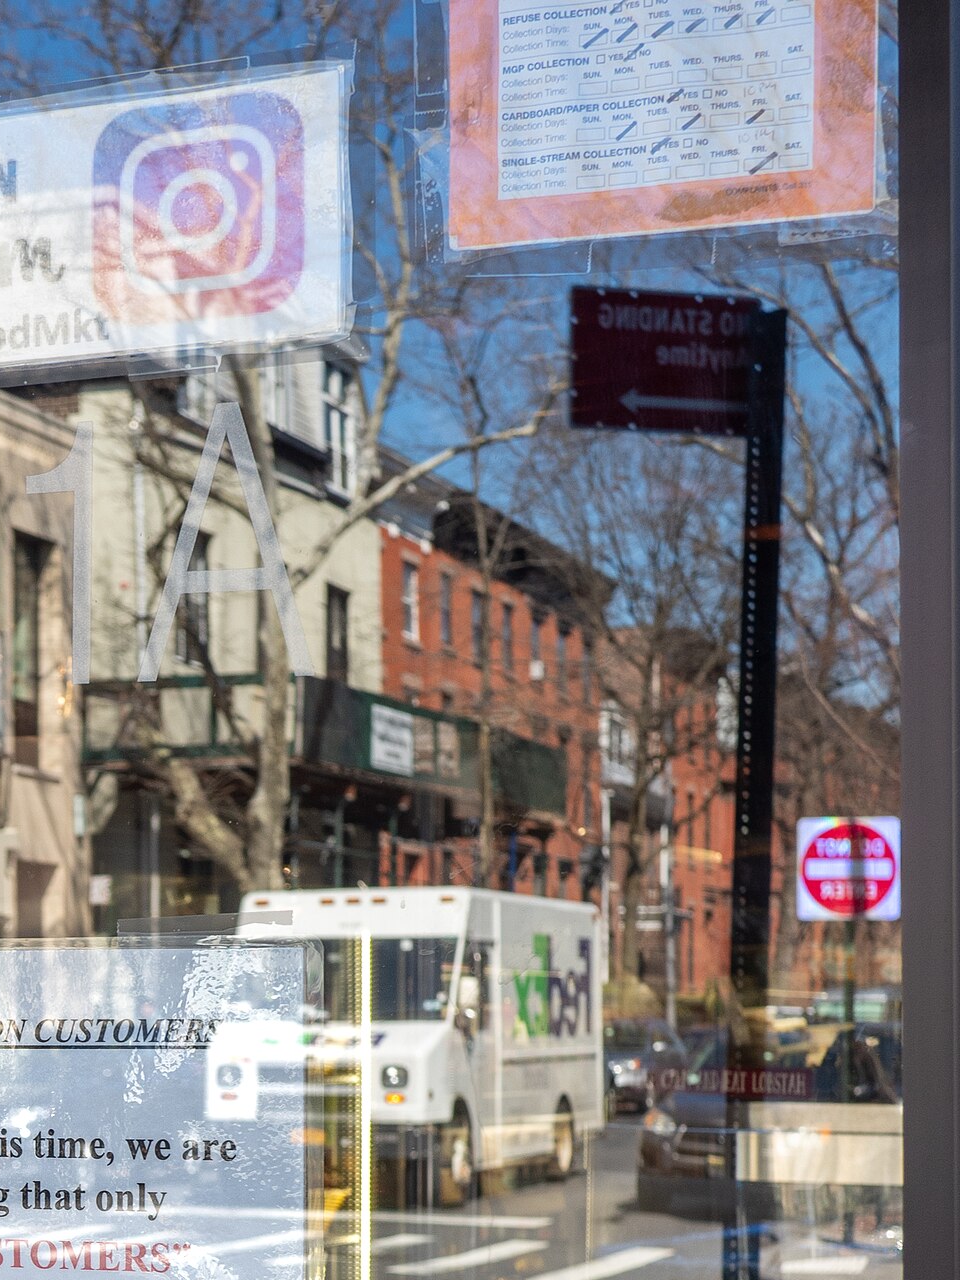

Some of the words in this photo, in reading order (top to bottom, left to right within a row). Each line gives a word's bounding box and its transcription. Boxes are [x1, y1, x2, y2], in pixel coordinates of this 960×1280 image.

[503, 13, 540, 26] REFUSE
[543, 6, 607, 20] COLLECTION
[624, 1, 640, 10] YES
[614, 16, 634, 25] MON.
[648, 10, 672, 19] TUES.
[714, 4, 744, 13] THURS.
[503, 26, 542, 40] Collection
[546, 24, 570, 35] Days:
[502, 43, 542, 54] Collection
[546, 40, 568, 48] Time:
[502, 65, 524, 75] MGP
[527, 58, 590, 70] COLLECTION
[614, 66, 636, 75] MON.
[648, 61, 672, 70] TUES.
[682, 58, 704, 66] WED.
[713, 54, 744, 64] THURS.
[754, 50, 770, 59] FRI.
[788, 45, 804, 53] SAT.
[502, 77, 542, 89] Collection
[546, 73, 568, 84] Days:
[501, 91, 542, 102] Collection
[546, 88, 568, 97] Time:
[502, 102, 600, 122] CARDBOARD/PAPER
[602, 96, 664, 111] COLLECTION
[682, 91, 698, 99] YES
[714, 89, 728, 97] NO
[612, 113, 634, 121] MON.
[646, 107, 669, 116] TUES.
[680, 104, 701, 112] WED.
[710, 101, 741, 110] THURS.
[752, 98, 768, 106] FRI.
[786, 92, 802, 101] SAT.
[501, 120, 542, 132] Collection
[545, 117, 568, 128] Days:
[501, 136, 542, 148] Collection
[545, 133, 567, 142] Time:
[502, 151, 580, 168] SINGLE-STREAM
[584, 145, 646, 160] COLLECTION
[696, 138, 708, 146] NO
[612, 160, 633, 168] MON.
[647, 155, 669, 164] TUES.
[680, 152, 701, 160] WED.
[710, 149, 740, 158] THURS.
[785, 142, 802, 150] SAT.
[502, 168, 542, 180] Collection
[544, 165, 567, 176] Days:
[502, 182, 542, 193] Collection
[544, 180, 566, 188] Time:
[34, 1017, 226, 1045] CUSTOMERS
[34, 1130, 114, 1166] time,
[125, 1138, 172, 1160] we
[182, 1140, 238, 1163] are
[20, 1182, 86, 1212] that
[96, 1184, 168, 1222] only
